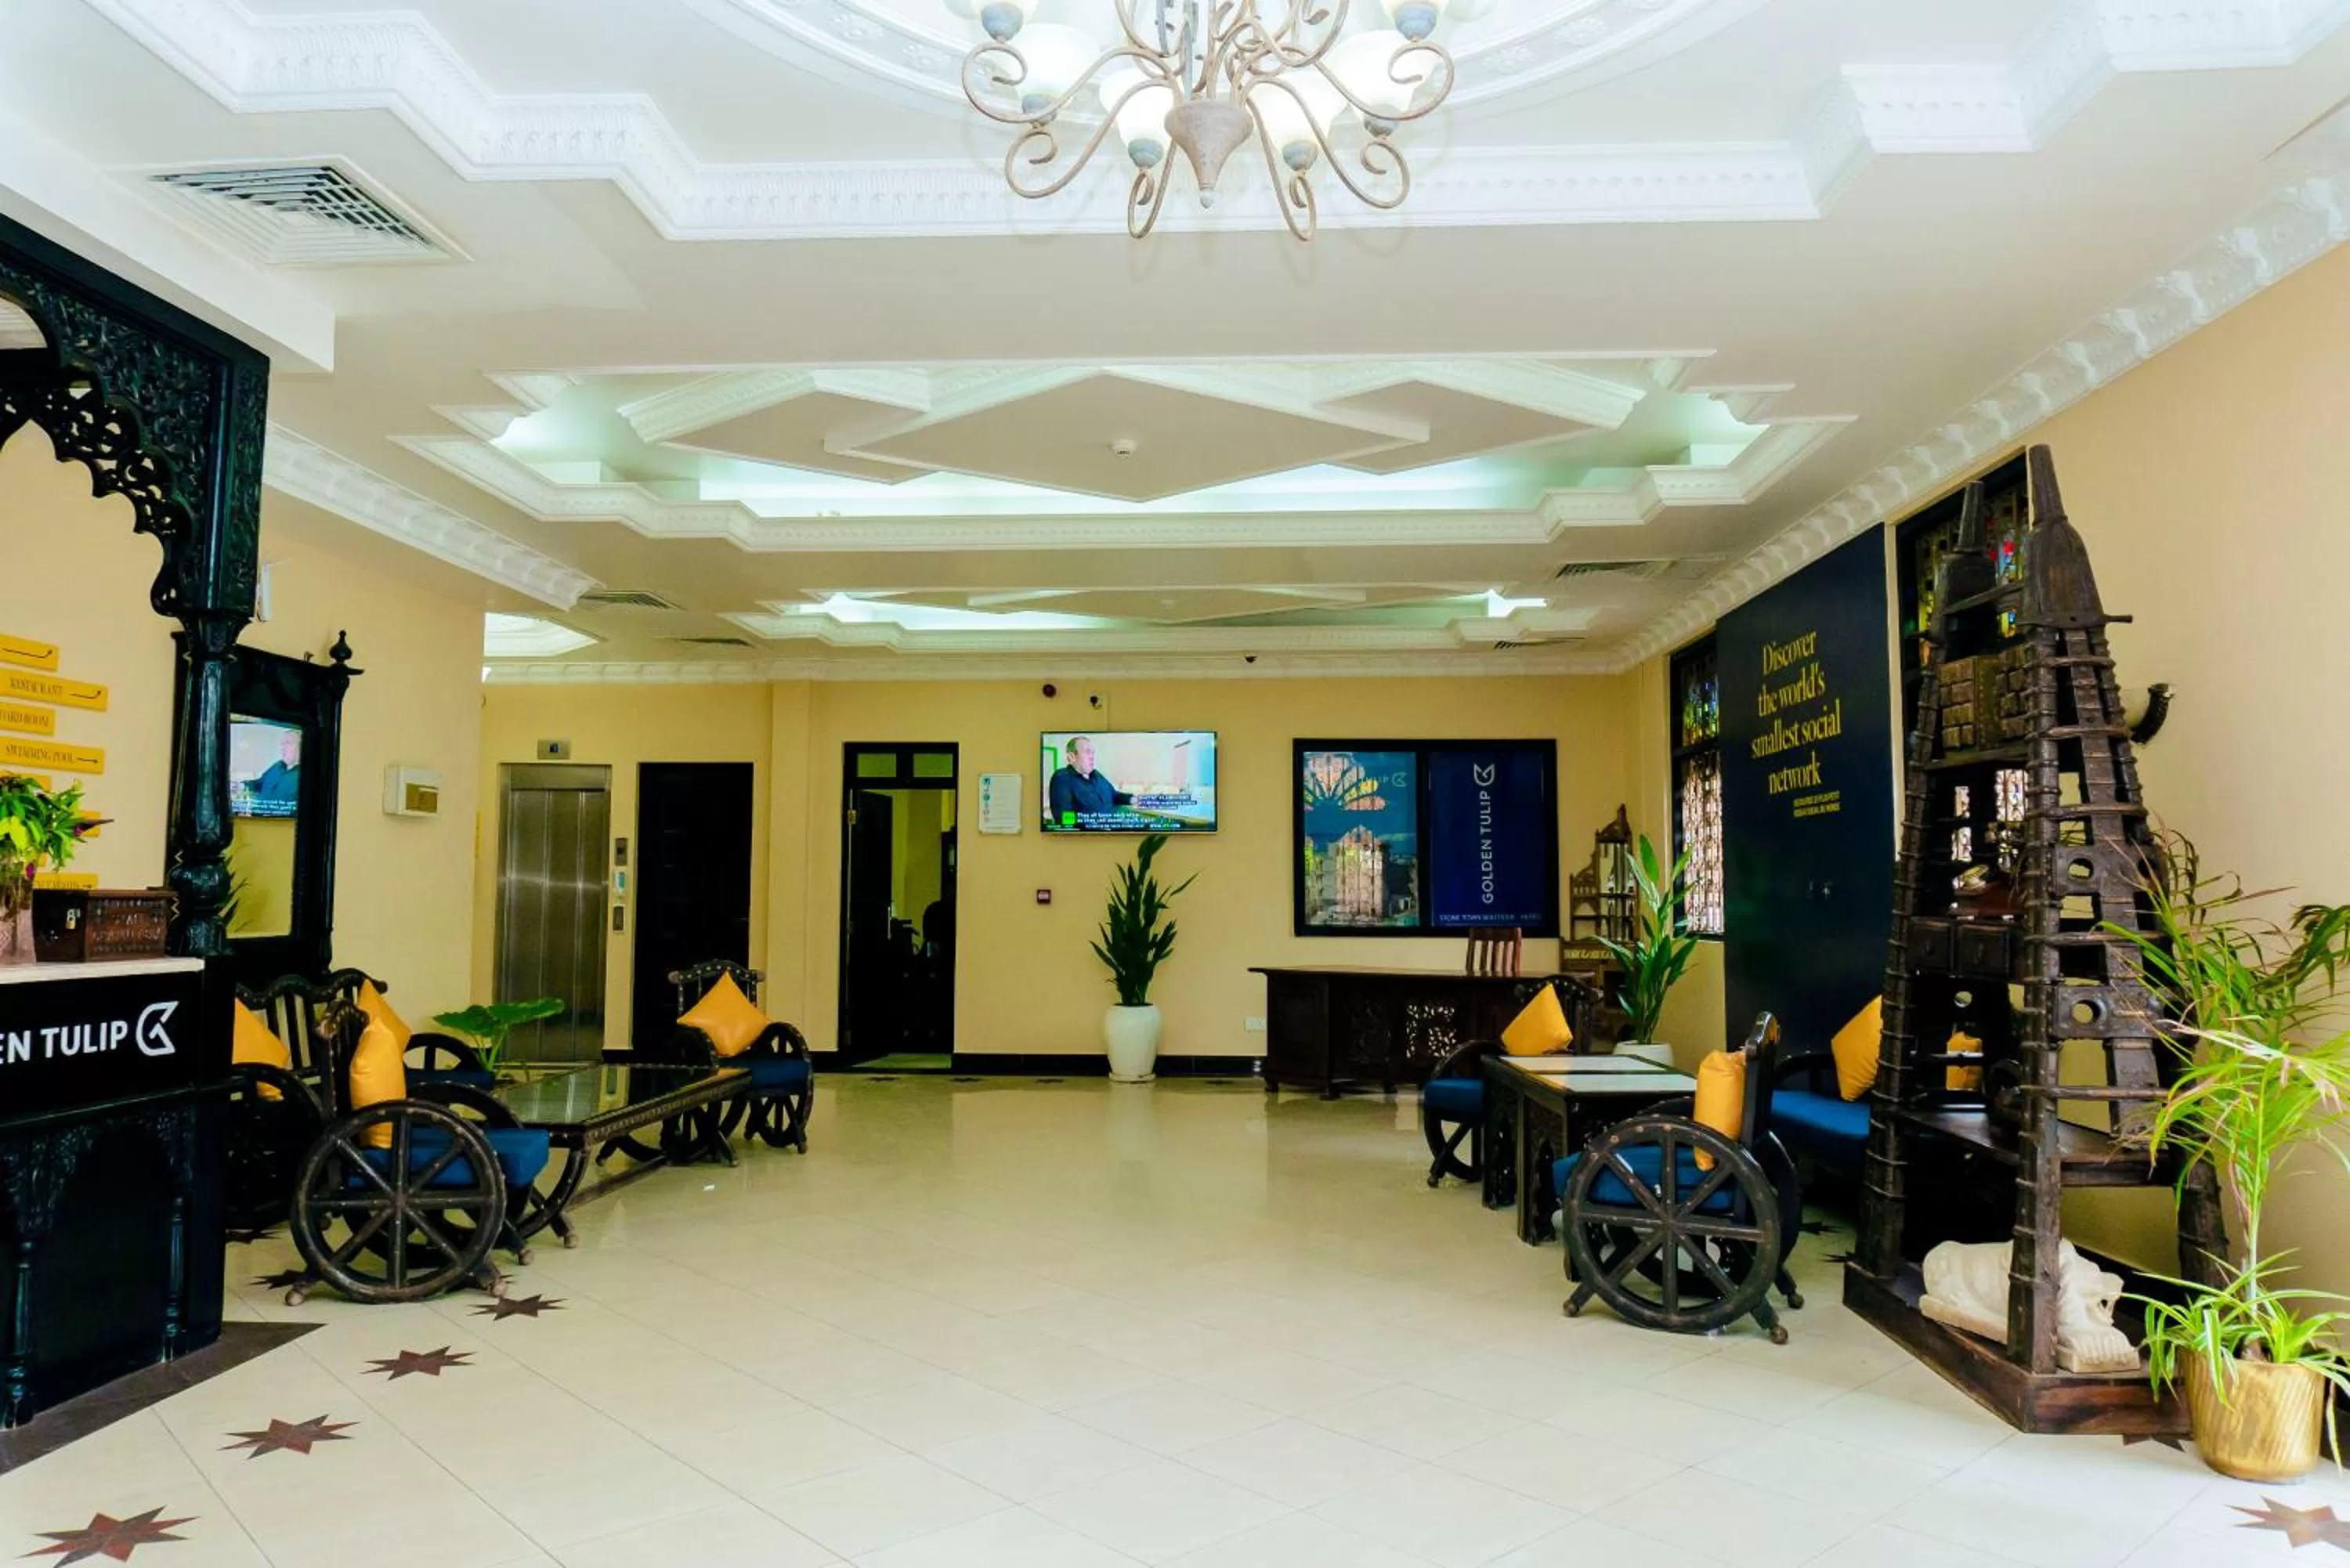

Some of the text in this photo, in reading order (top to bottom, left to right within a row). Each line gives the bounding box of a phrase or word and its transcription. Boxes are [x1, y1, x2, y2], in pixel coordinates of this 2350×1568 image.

[1762, 631, 1817, 675] Discover
[1758, 662, 1826, 717] the world's
[1751, 698, 1841, 759] smallest social
[1768, 750, 1822, 795] network
[1480, 791, 1494, 904] GOLDEN TULIP
[40, 1021, 128, 1058] TULIP
